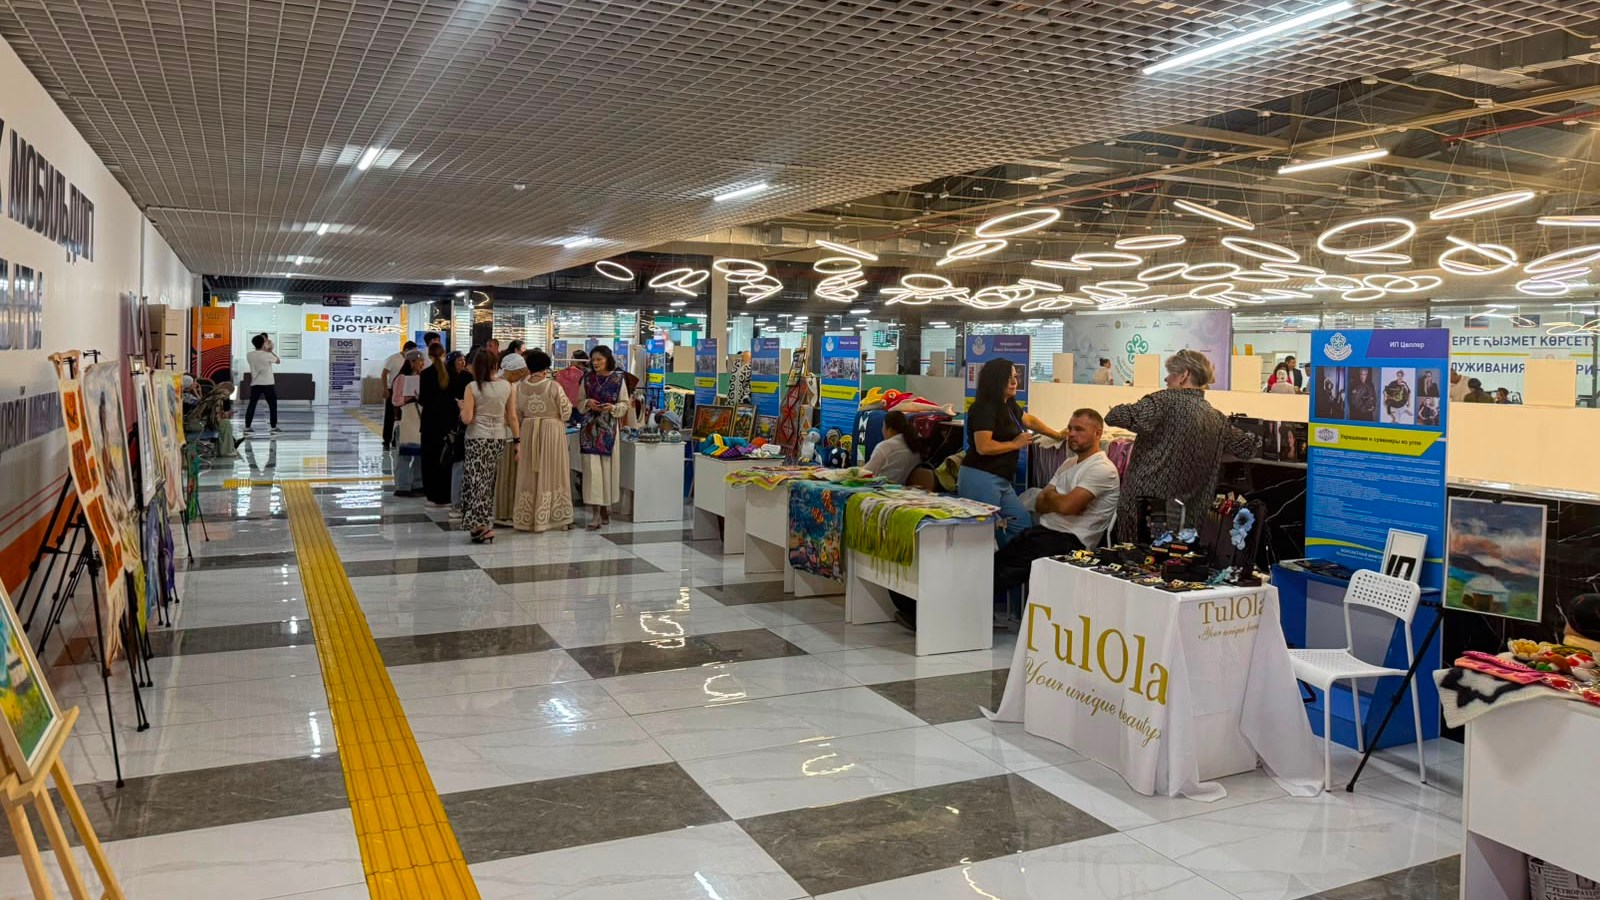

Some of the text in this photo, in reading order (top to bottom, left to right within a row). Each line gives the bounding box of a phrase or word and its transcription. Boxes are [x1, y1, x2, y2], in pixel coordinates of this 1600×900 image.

[331, 314, 394, 324] GARANT
[331, 324, 394, 334] IPOT
[1483, 336, 1536, 347] ҚЫЗМЕТ
[1027, 602, 1169, 706] TulOla
[1025, 656, 1064, 692] Your
[1065, 688, 1117, 716] unique
